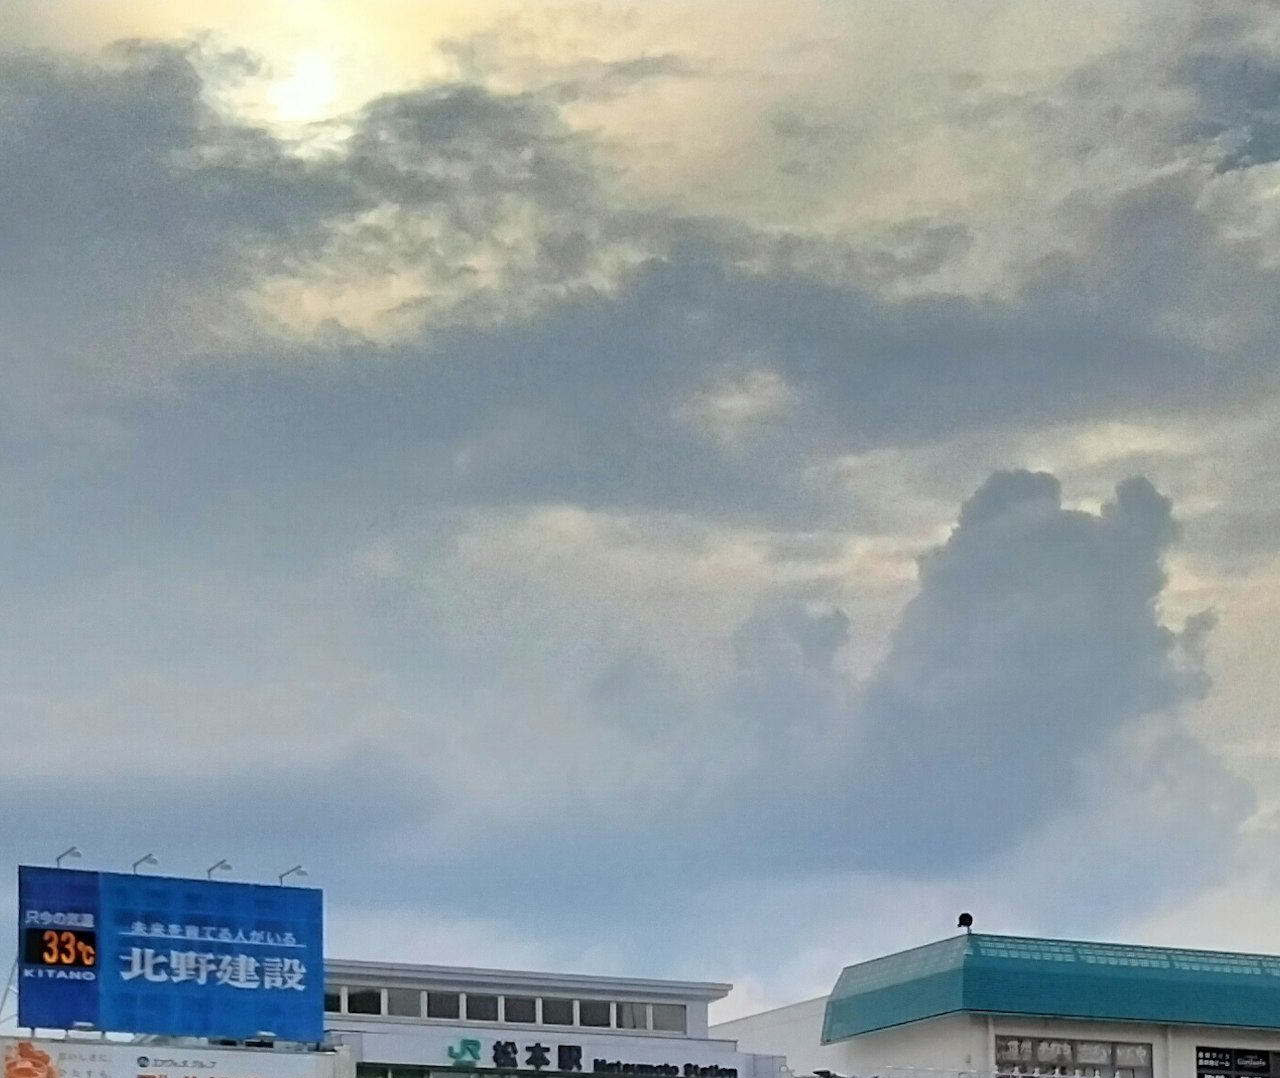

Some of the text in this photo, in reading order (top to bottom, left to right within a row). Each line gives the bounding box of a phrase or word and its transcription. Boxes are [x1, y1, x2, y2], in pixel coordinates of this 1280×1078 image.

[24, 968, 96, 981] KITANO
[119, 947, 307, 991] 北野建設
[447, 1039, 480, 1062] JR
[492, 1041, 582, 1071] 松本駅
[683, 1062, 738, 1078] Station
